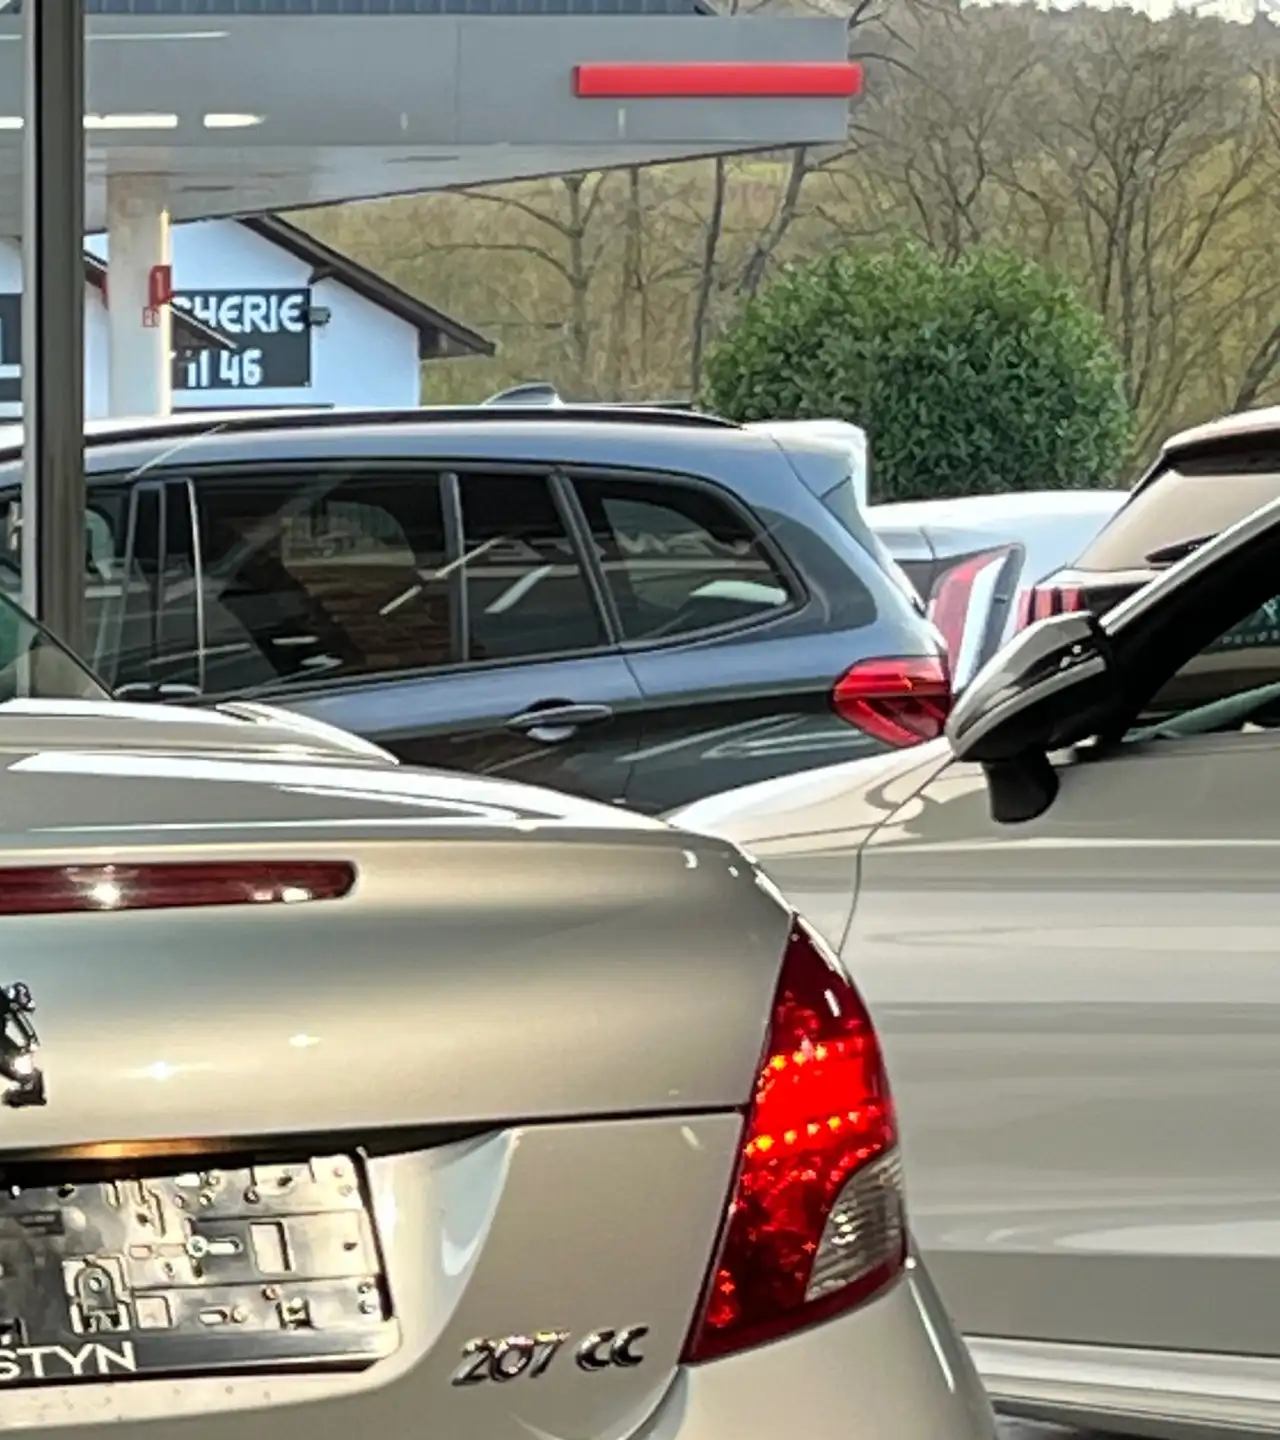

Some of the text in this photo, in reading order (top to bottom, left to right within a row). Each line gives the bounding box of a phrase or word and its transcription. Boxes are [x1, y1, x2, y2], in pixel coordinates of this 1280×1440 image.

[220, 348, 263, 387] 46
[452, 1326, 649, 1386] 207 CC
